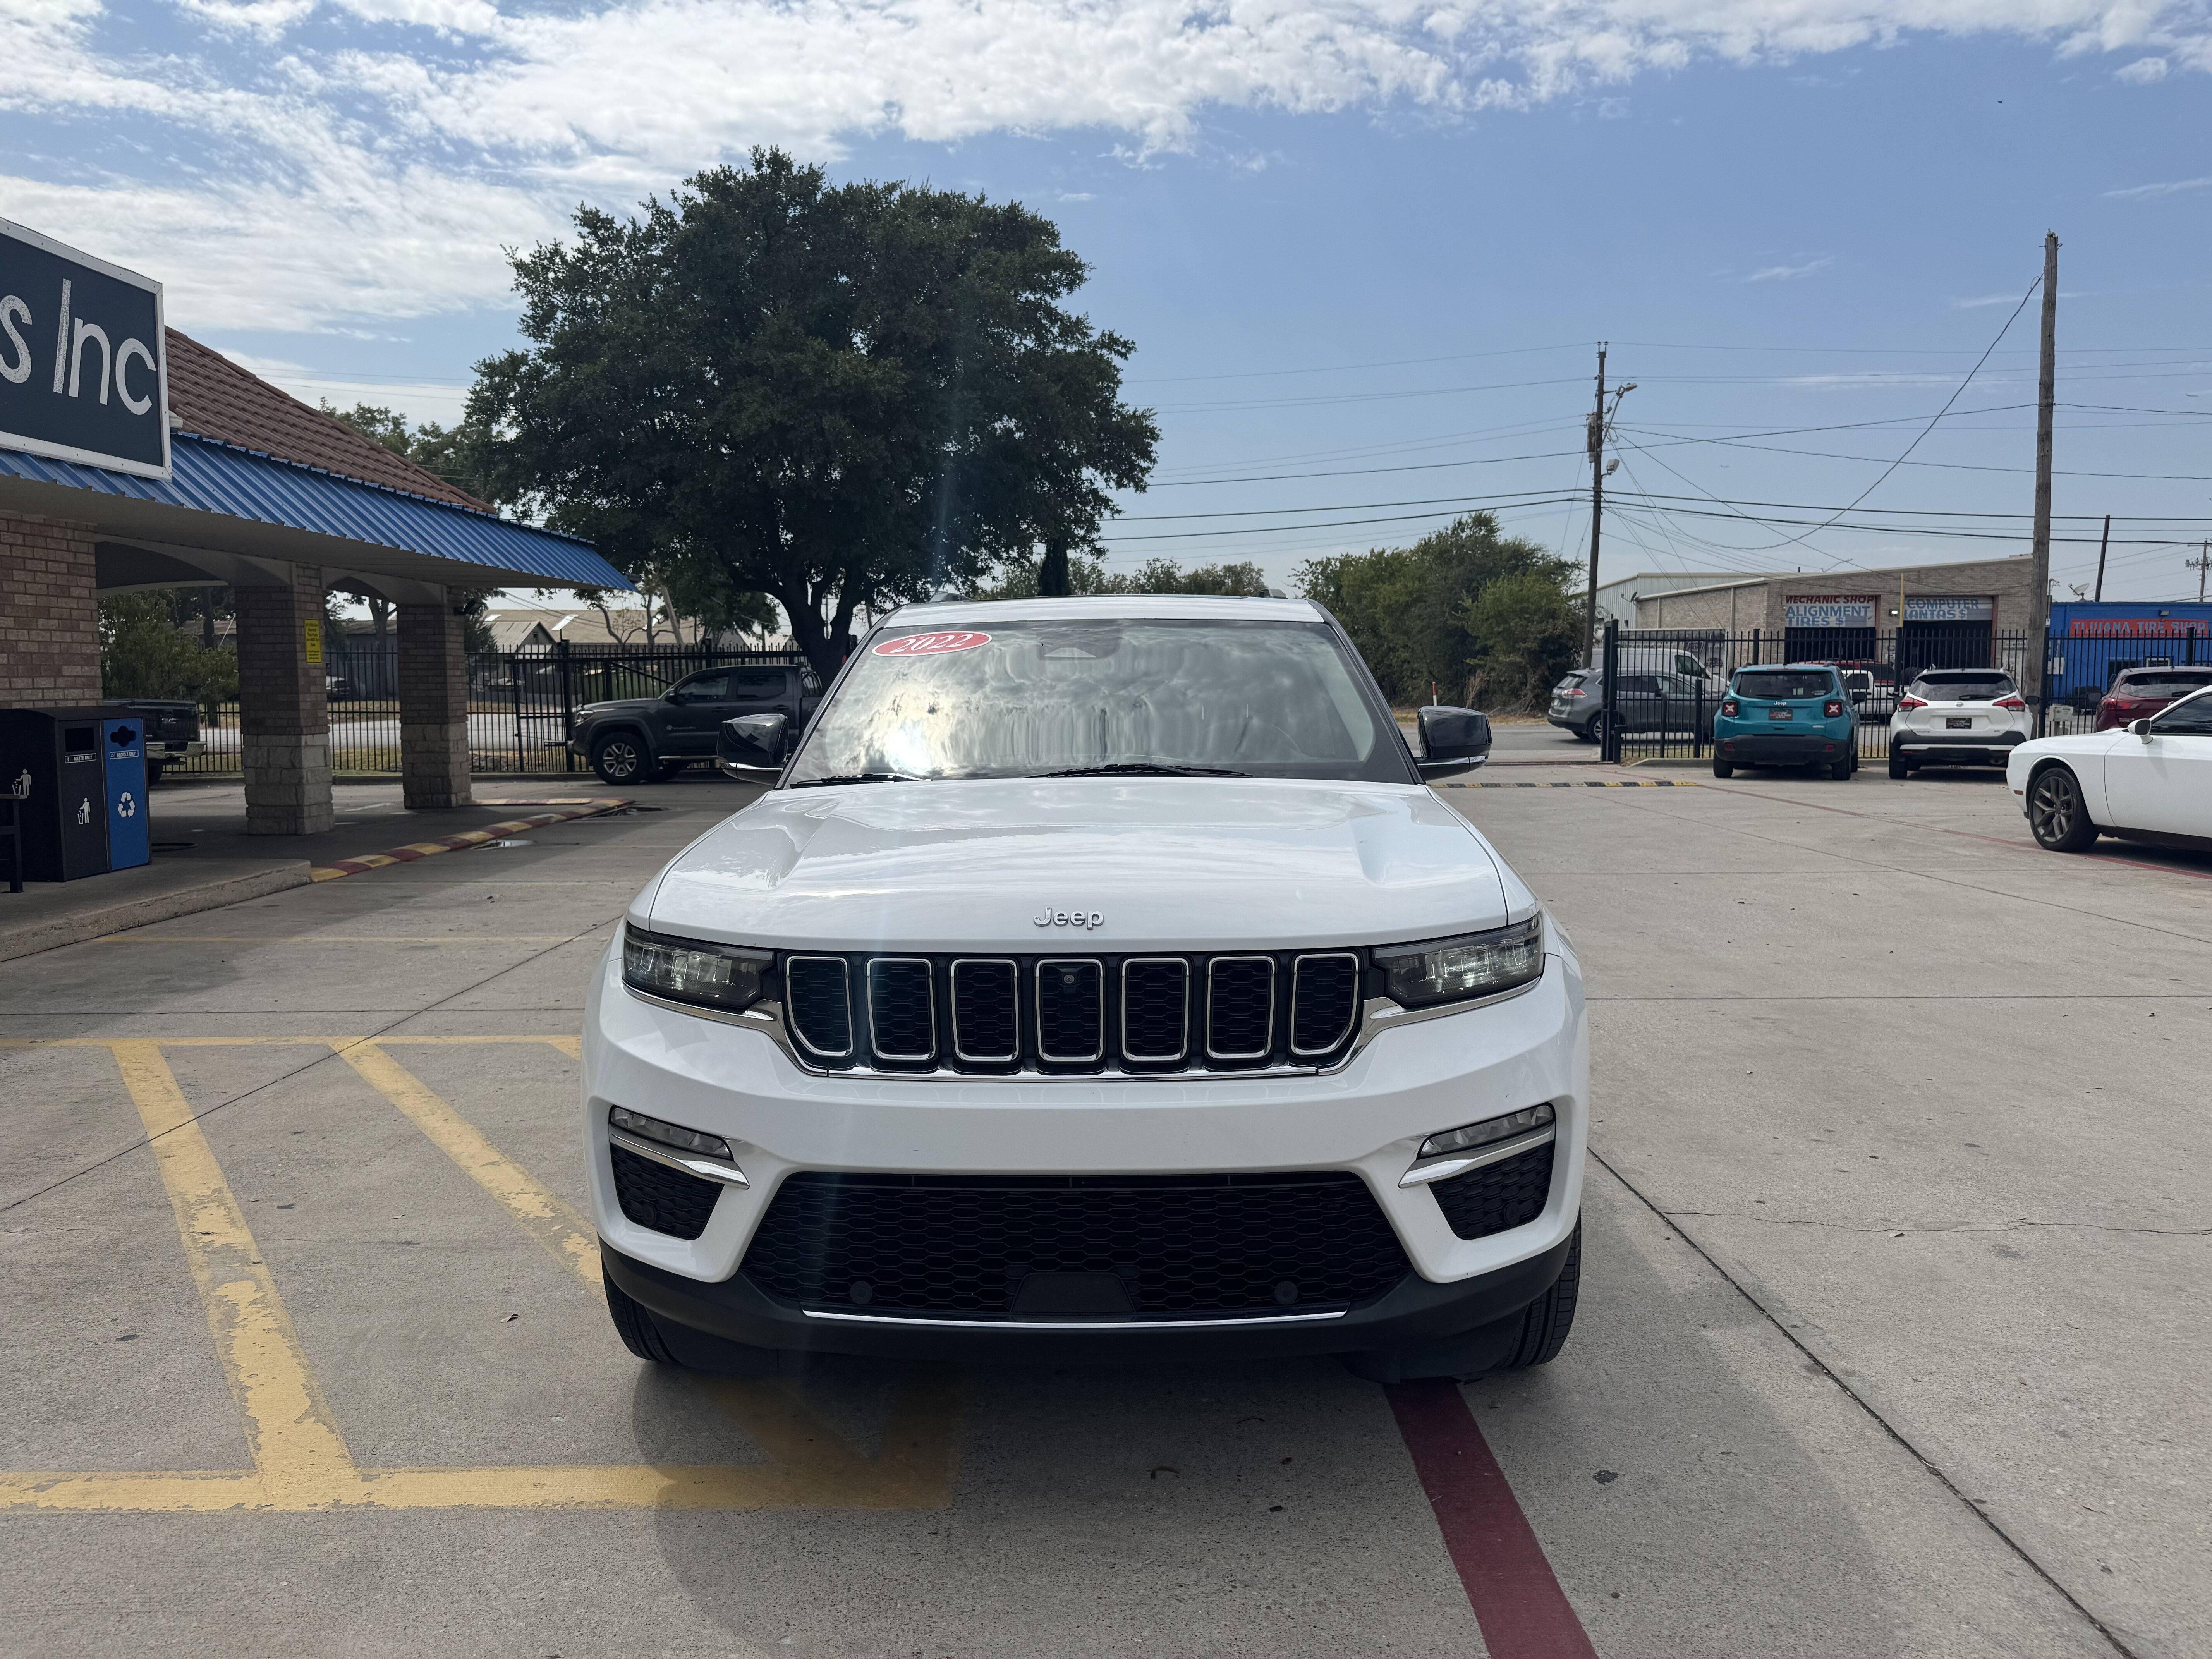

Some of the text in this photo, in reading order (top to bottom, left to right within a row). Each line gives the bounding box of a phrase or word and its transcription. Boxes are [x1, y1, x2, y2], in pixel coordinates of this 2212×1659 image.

[53, 278, 156, 415] Inc
[1786, 595, 1875, 604] MECHANIC SHOP
[1907, 599, 1979, 610] COMPUTER
[1785, 606, 1870, 617] ALIGNMENT
[1904, 608, 1966, 619] LANTAS $
[1786, 617, 1844, 626] TIRES $
[2073, 622, 2206, 634] TIJUANA TIRE SHOP
[888, 634, 974, 654] 2022
[1034, 907, 1104, 930] Jeep
